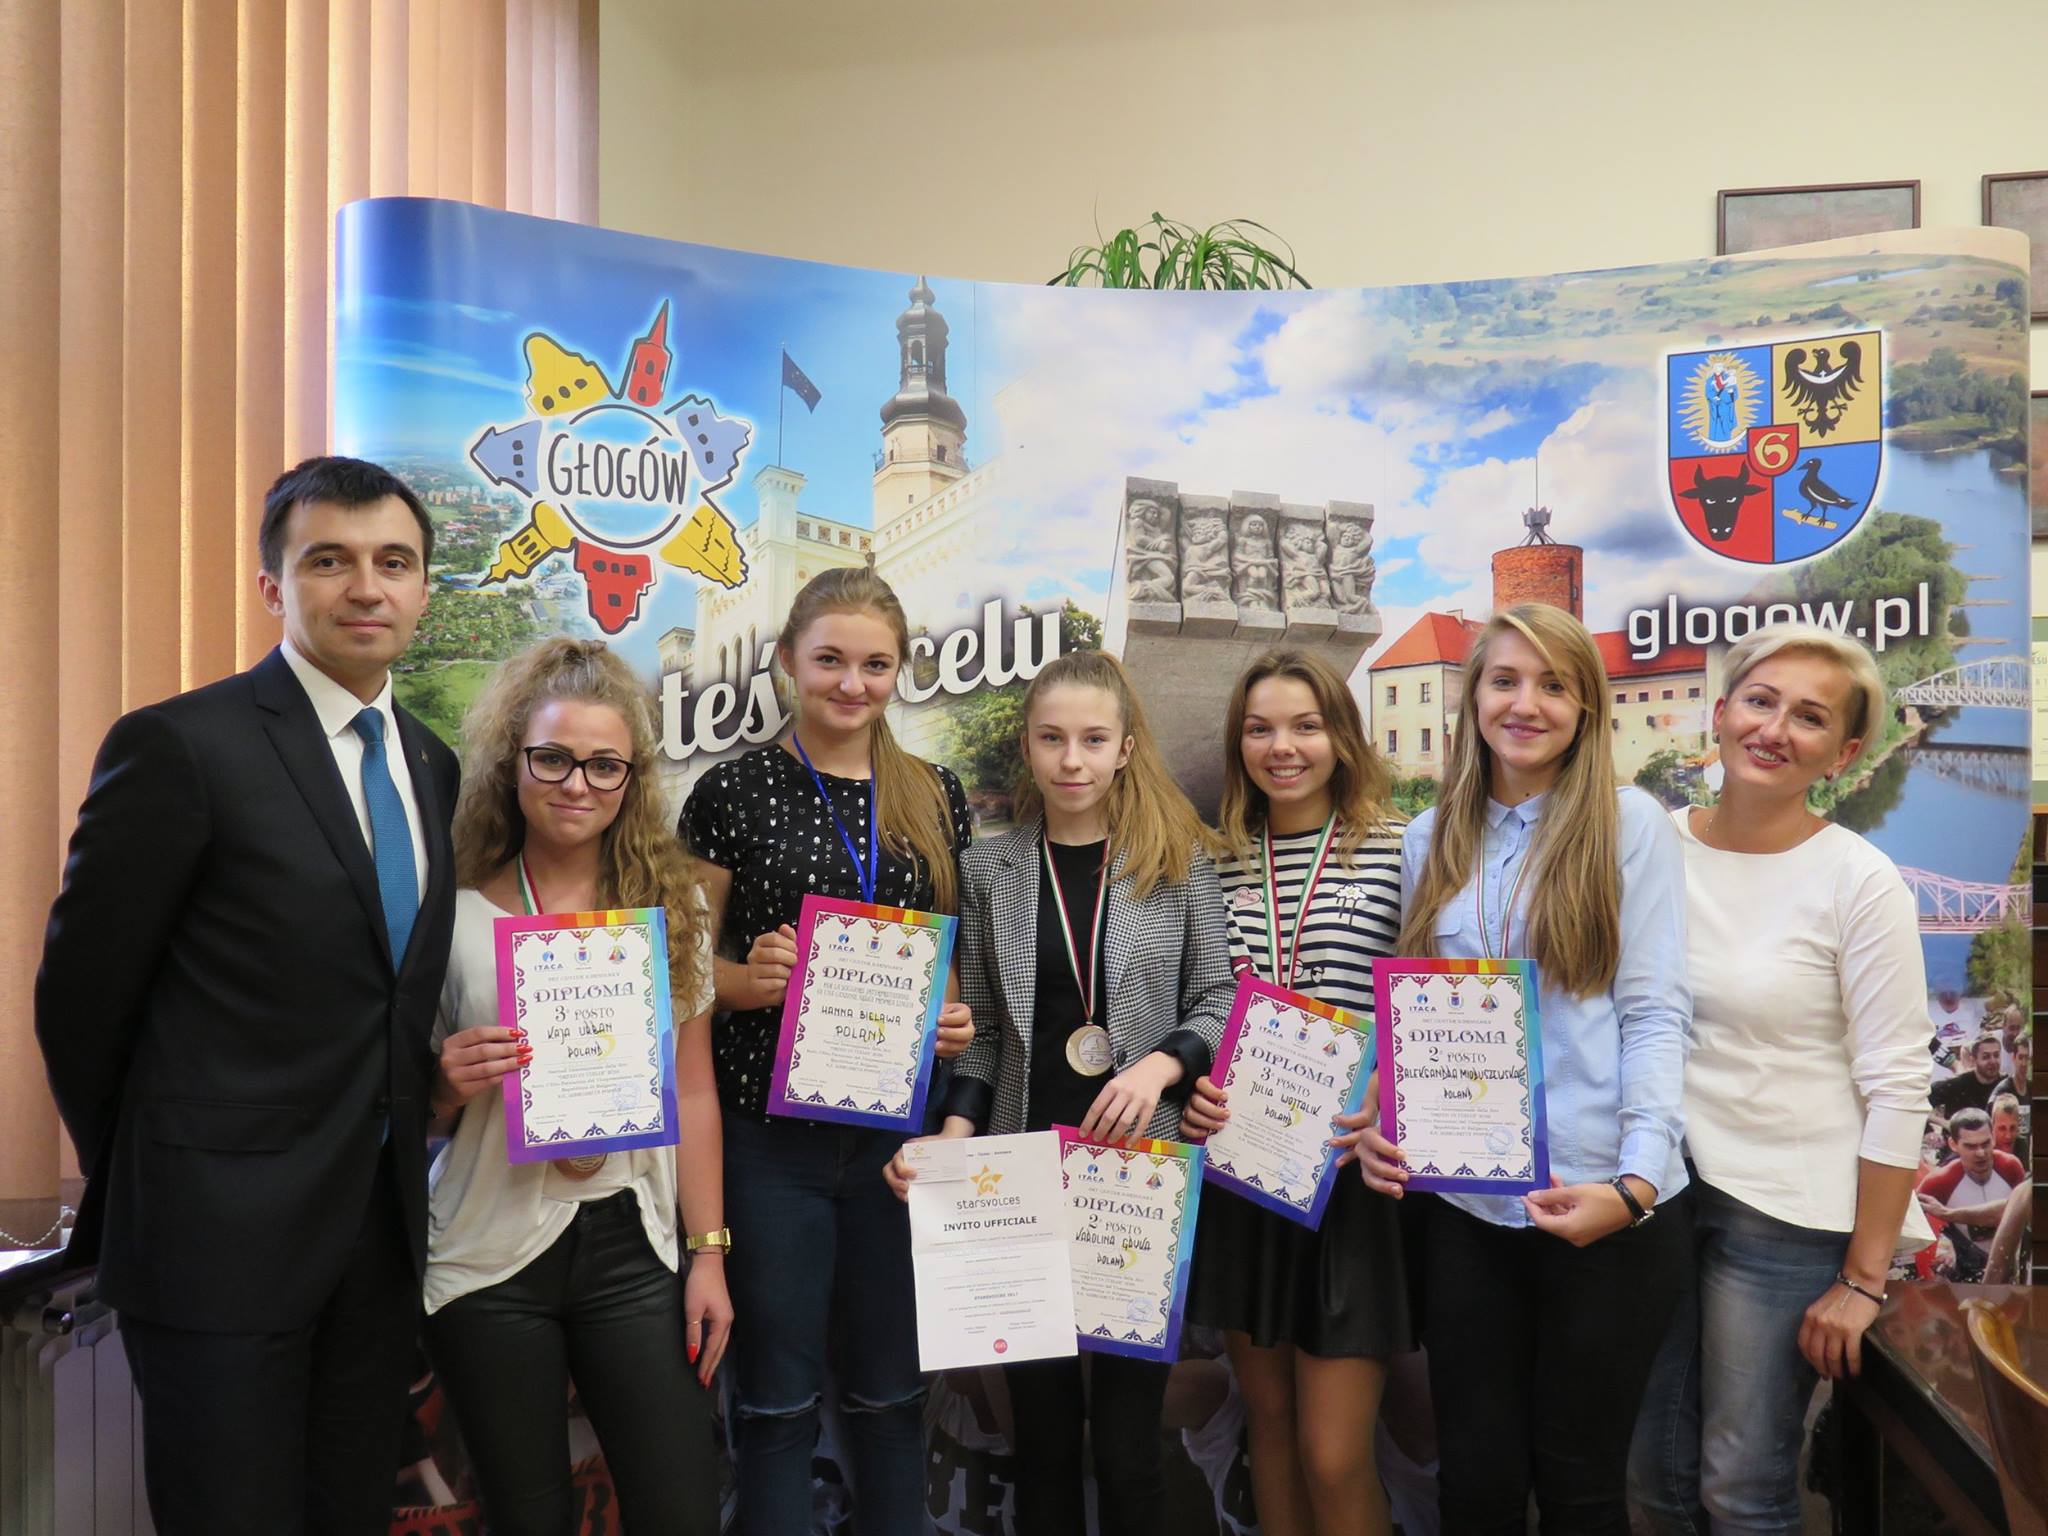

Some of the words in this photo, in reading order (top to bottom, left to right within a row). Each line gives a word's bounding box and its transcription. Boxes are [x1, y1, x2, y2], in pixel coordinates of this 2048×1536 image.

[547, 433, 687, 504] GŁOGÓW
[1628, 582, 1929, 660] glogow.pl
[655, 641, 793, 760] teś
[534, 963, 564, 971] ITACA
[822, 965, 913, 990] DIPLOMA
[533, 981, 636, 1002] DIPLOMA
[574, 1007, 615, 1020] POSTO
[836, 1025, 886, 1044] POLAND
[1408, 1029, 1507, 1044] DIPLOMA
[567, 1040, 603, 1058] POLAND
[1447, 1051, 1487, 1064] POSTO
[1250, 1046, 1335, 1088] DIPLOMA
[1276, 1077, 1310, 1097] POSTO
[1443, 1087, 1473, 1100] POLAND
[1264, 1104, 1293, 1127] POLAND
[956, 1195, 1021, 1210] starsvoices
[1073, 1195, 1165, 1220] DIPLOMA
[943, 1221, 981, 1232] INVITO
[984, 1215, 1037, 1228] UFFICIALE
[1105, 1221, 1142, 1236] POSTO
[1097, 1251, 1125, 1269] POLAND
